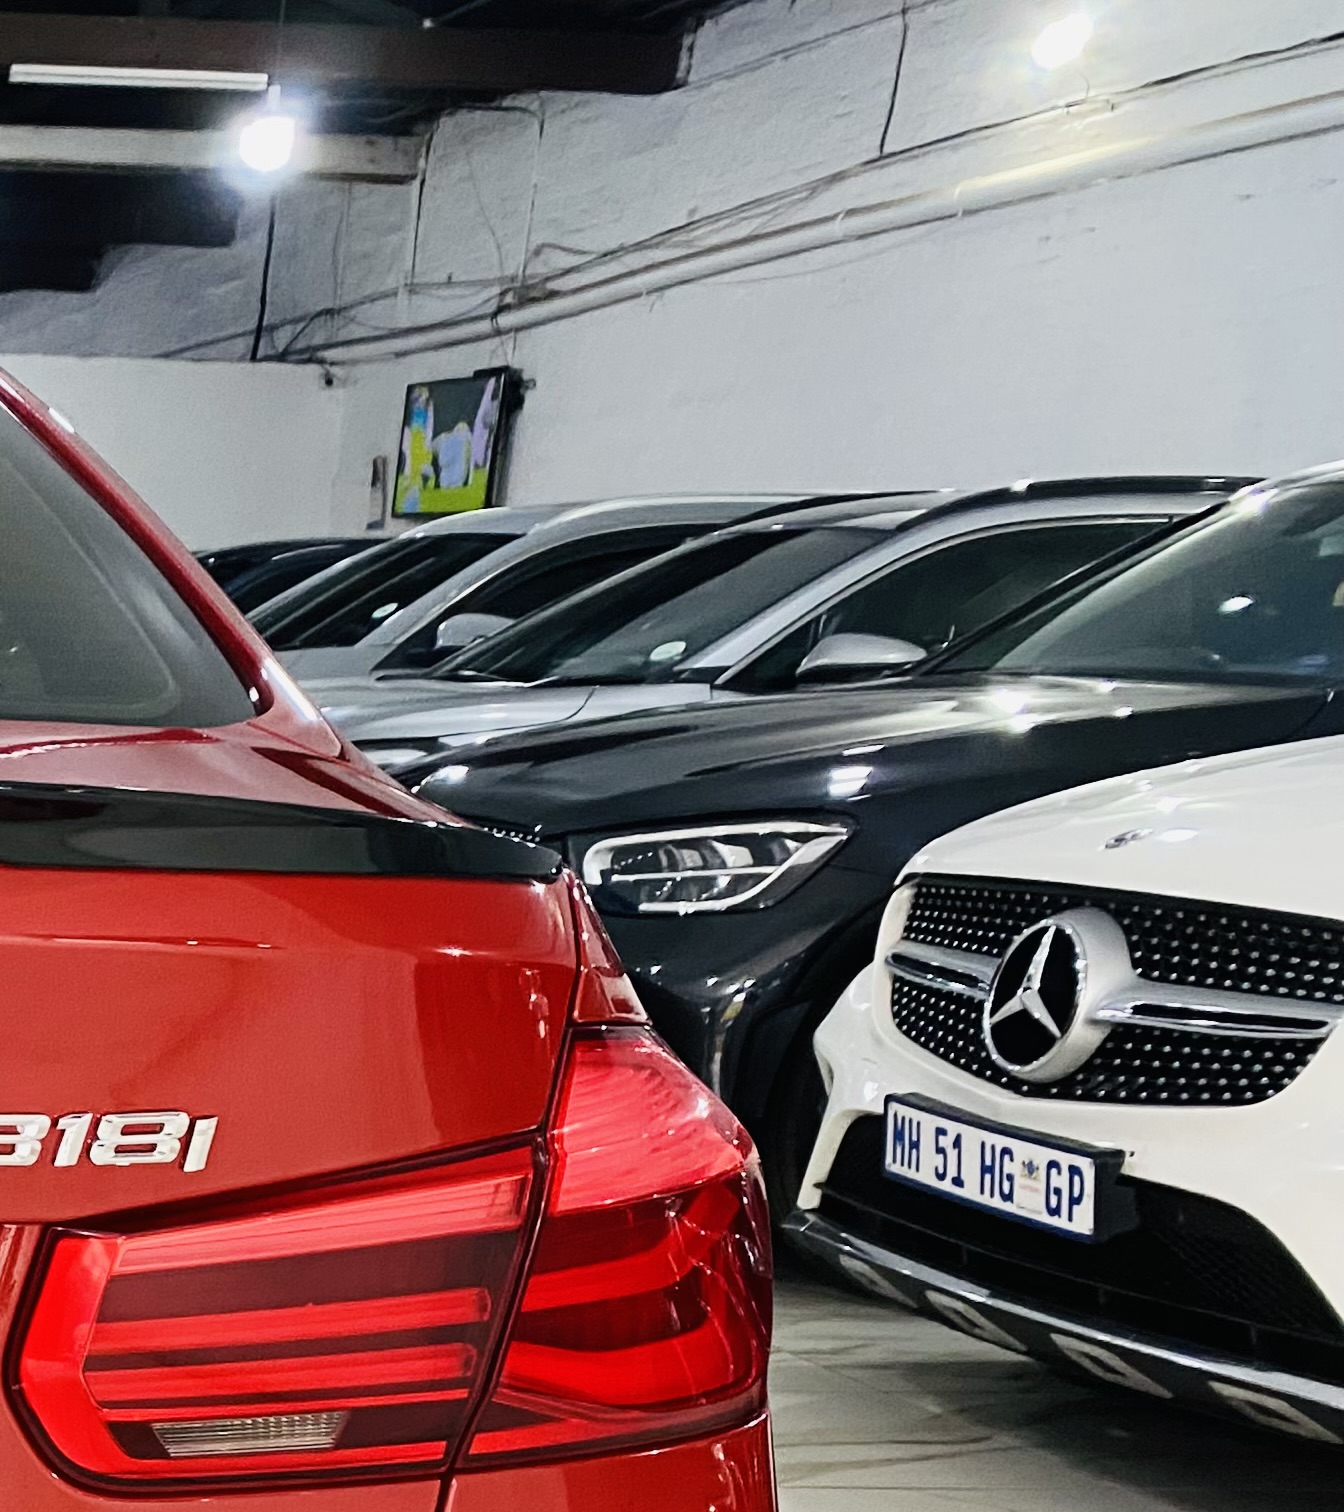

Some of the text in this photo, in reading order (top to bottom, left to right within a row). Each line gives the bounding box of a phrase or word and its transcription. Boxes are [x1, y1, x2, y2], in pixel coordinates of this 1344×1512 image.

[892, 1110, 1085, 1223] MH 51 HG GP
